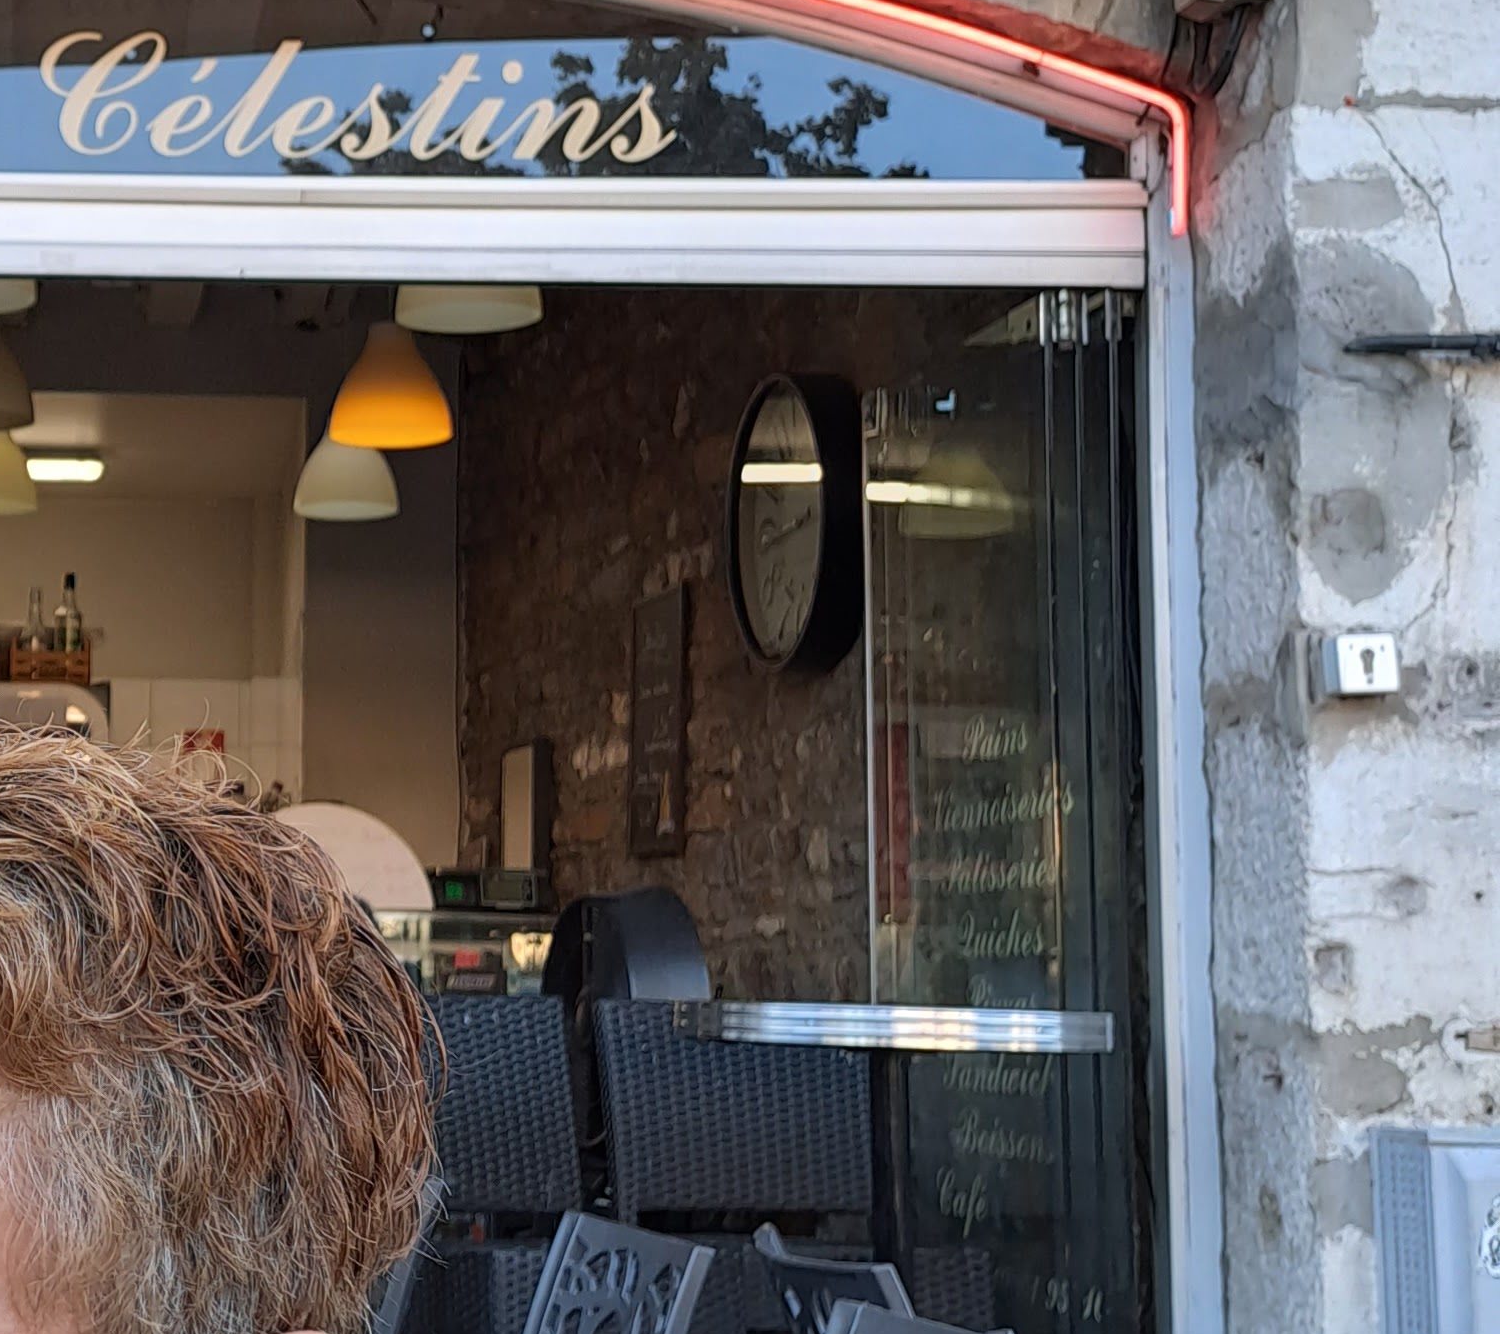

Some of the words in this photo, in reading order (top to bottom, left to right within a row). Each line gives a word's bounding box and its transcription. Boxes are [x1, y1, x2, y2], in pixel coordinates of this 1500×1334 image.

[37, 27, 679, 165] Célestins
[962, 713, 1029, 763] Pains
[958, 908, 1045, 958] Quiches
